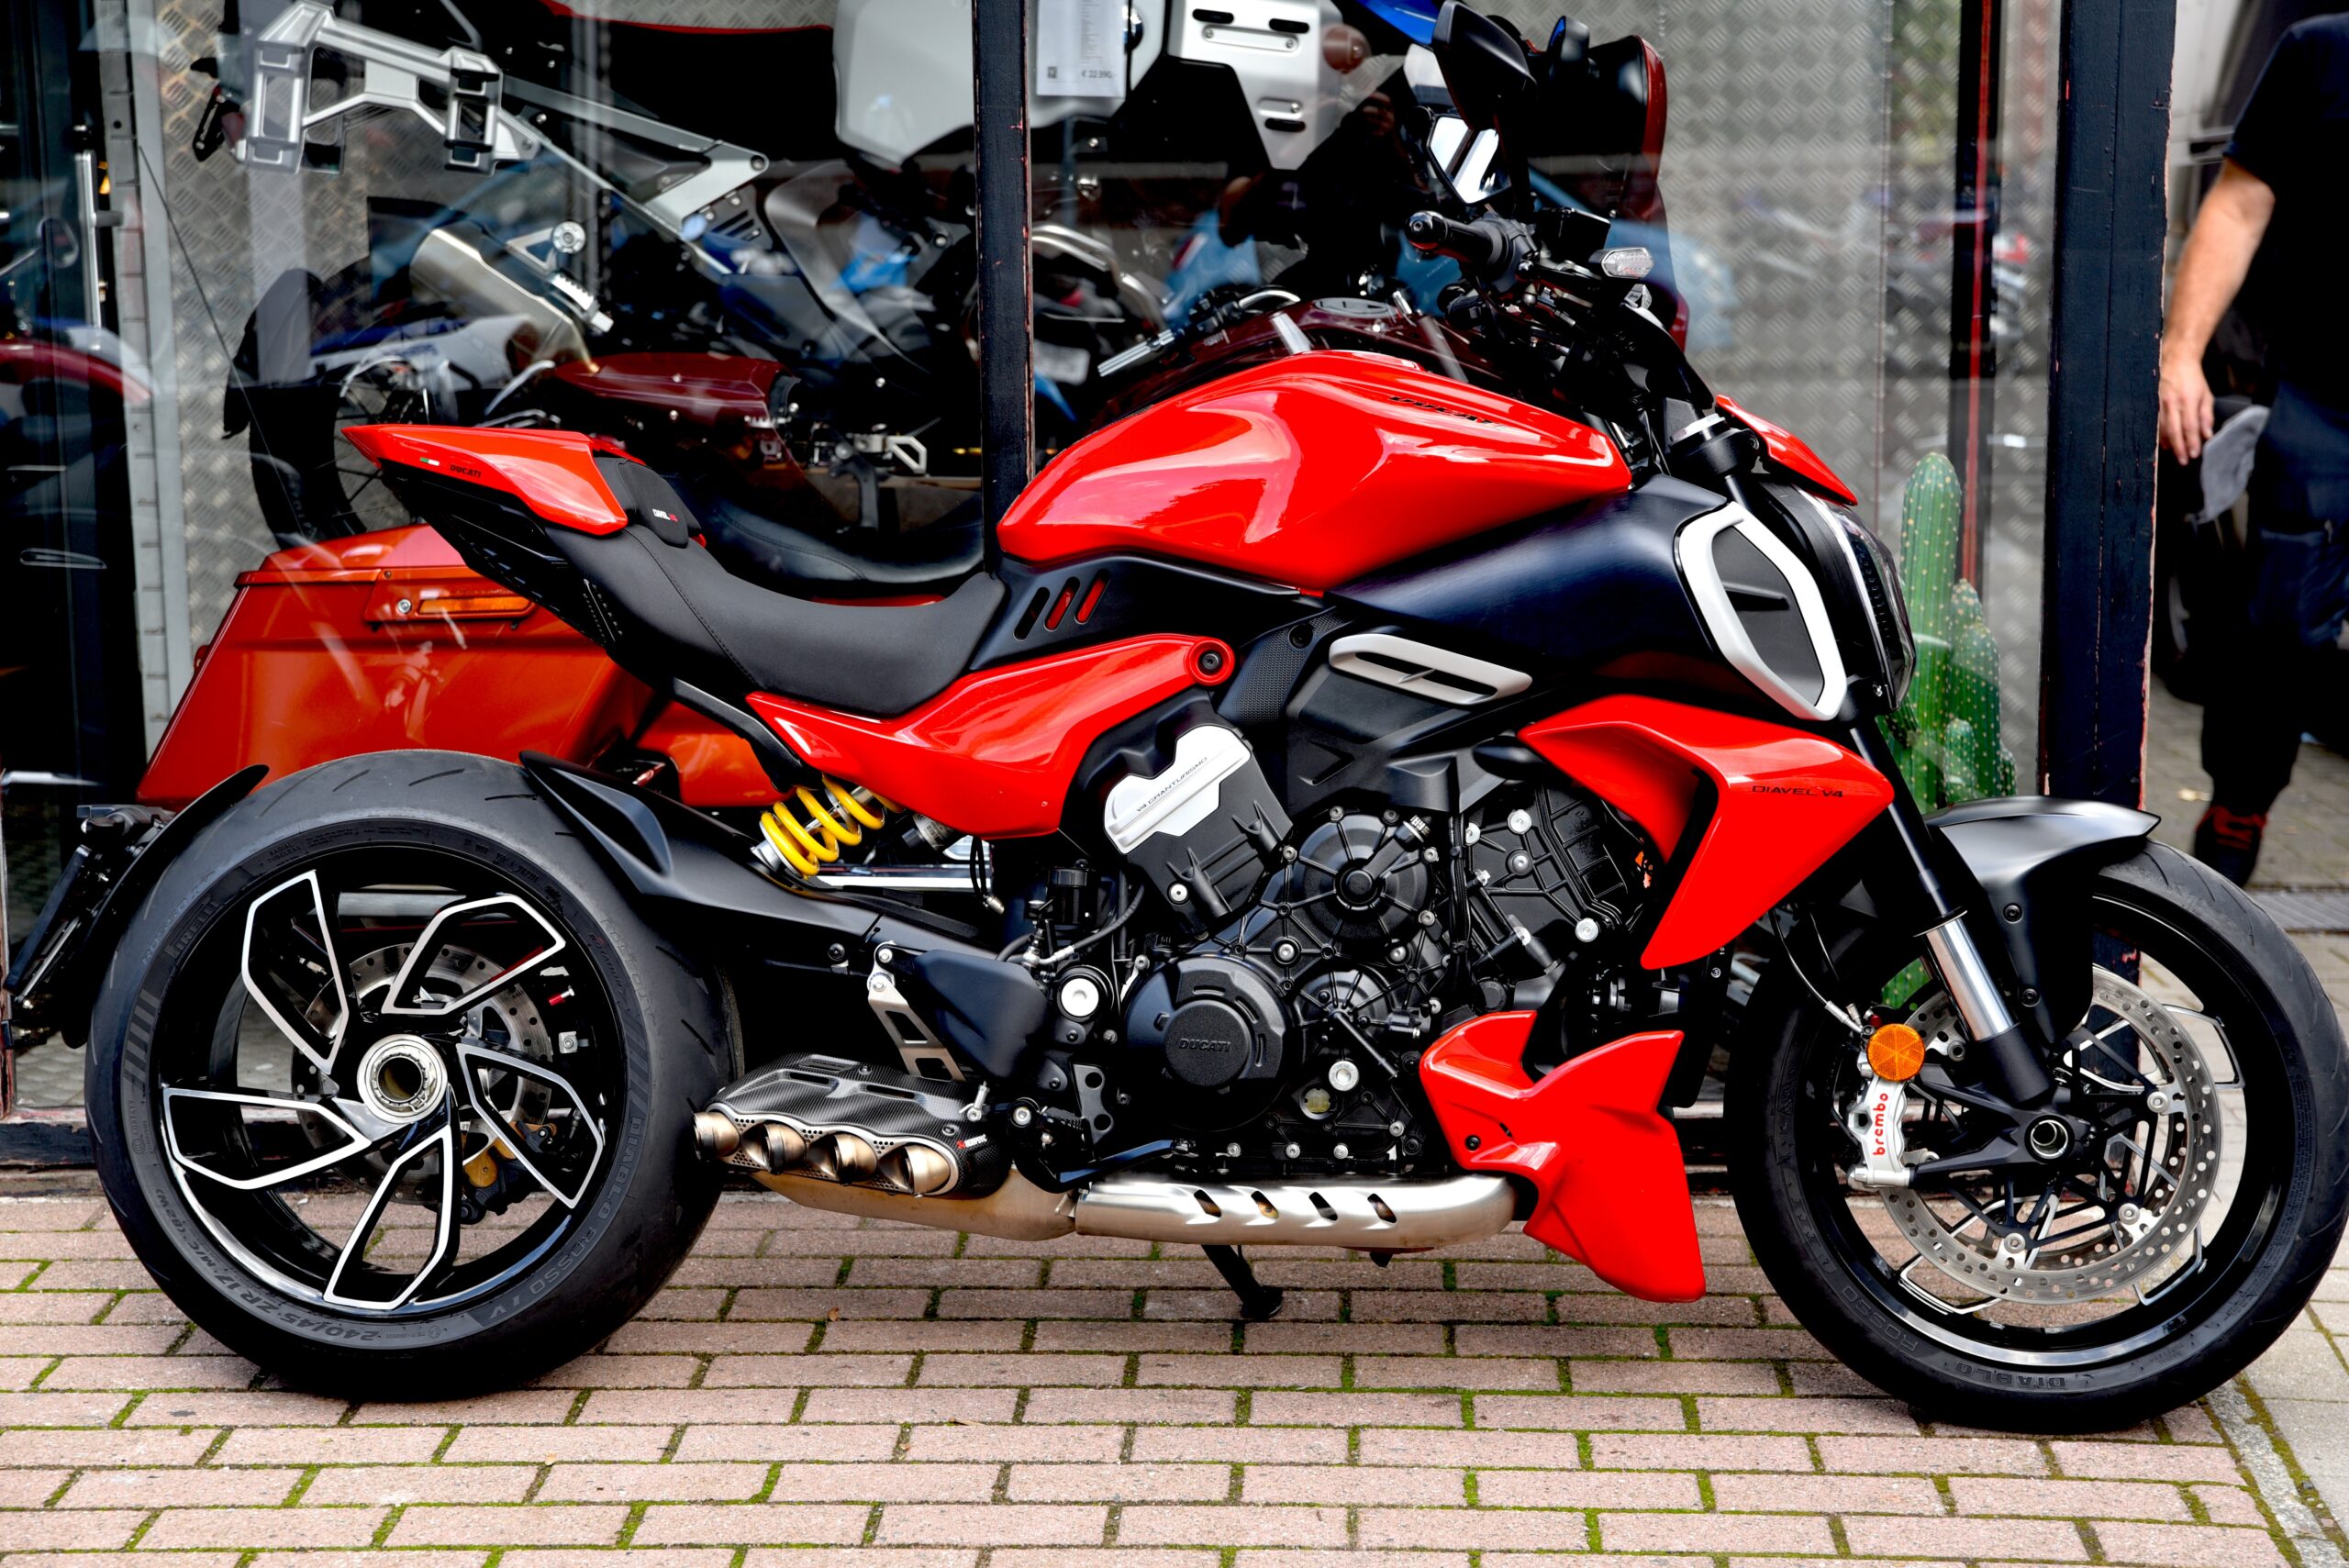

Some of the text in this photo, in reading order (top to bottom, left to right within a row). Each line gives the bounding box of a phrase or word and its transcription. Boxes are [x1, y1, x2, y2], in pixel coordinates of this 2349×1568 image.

[450, 464, 482, 477] DUCATI
[1137, 756, 1208, 812] V4 GRANTURISMO
[1752, 785, 1844, 798] DIAVEL V4
[1179, 1038, 1231, 1052] DUCATI
[1872, 1093, 1888, 1156] brembo
[597, 1117, 644, 1220] DIABLO
[187, 1240, 217, 1267] M/C
[529, 1226, 596, 1296] ROSSO
[214, 1273, 241, 1290] 17
[239, 1289, 281, 1314] ZR
[279, 1312, 383, 1341] 240/45
[1842, 1285, 1919, 1351] ROSSO
[1954, 1362, 2067, 1389] DIABLO
